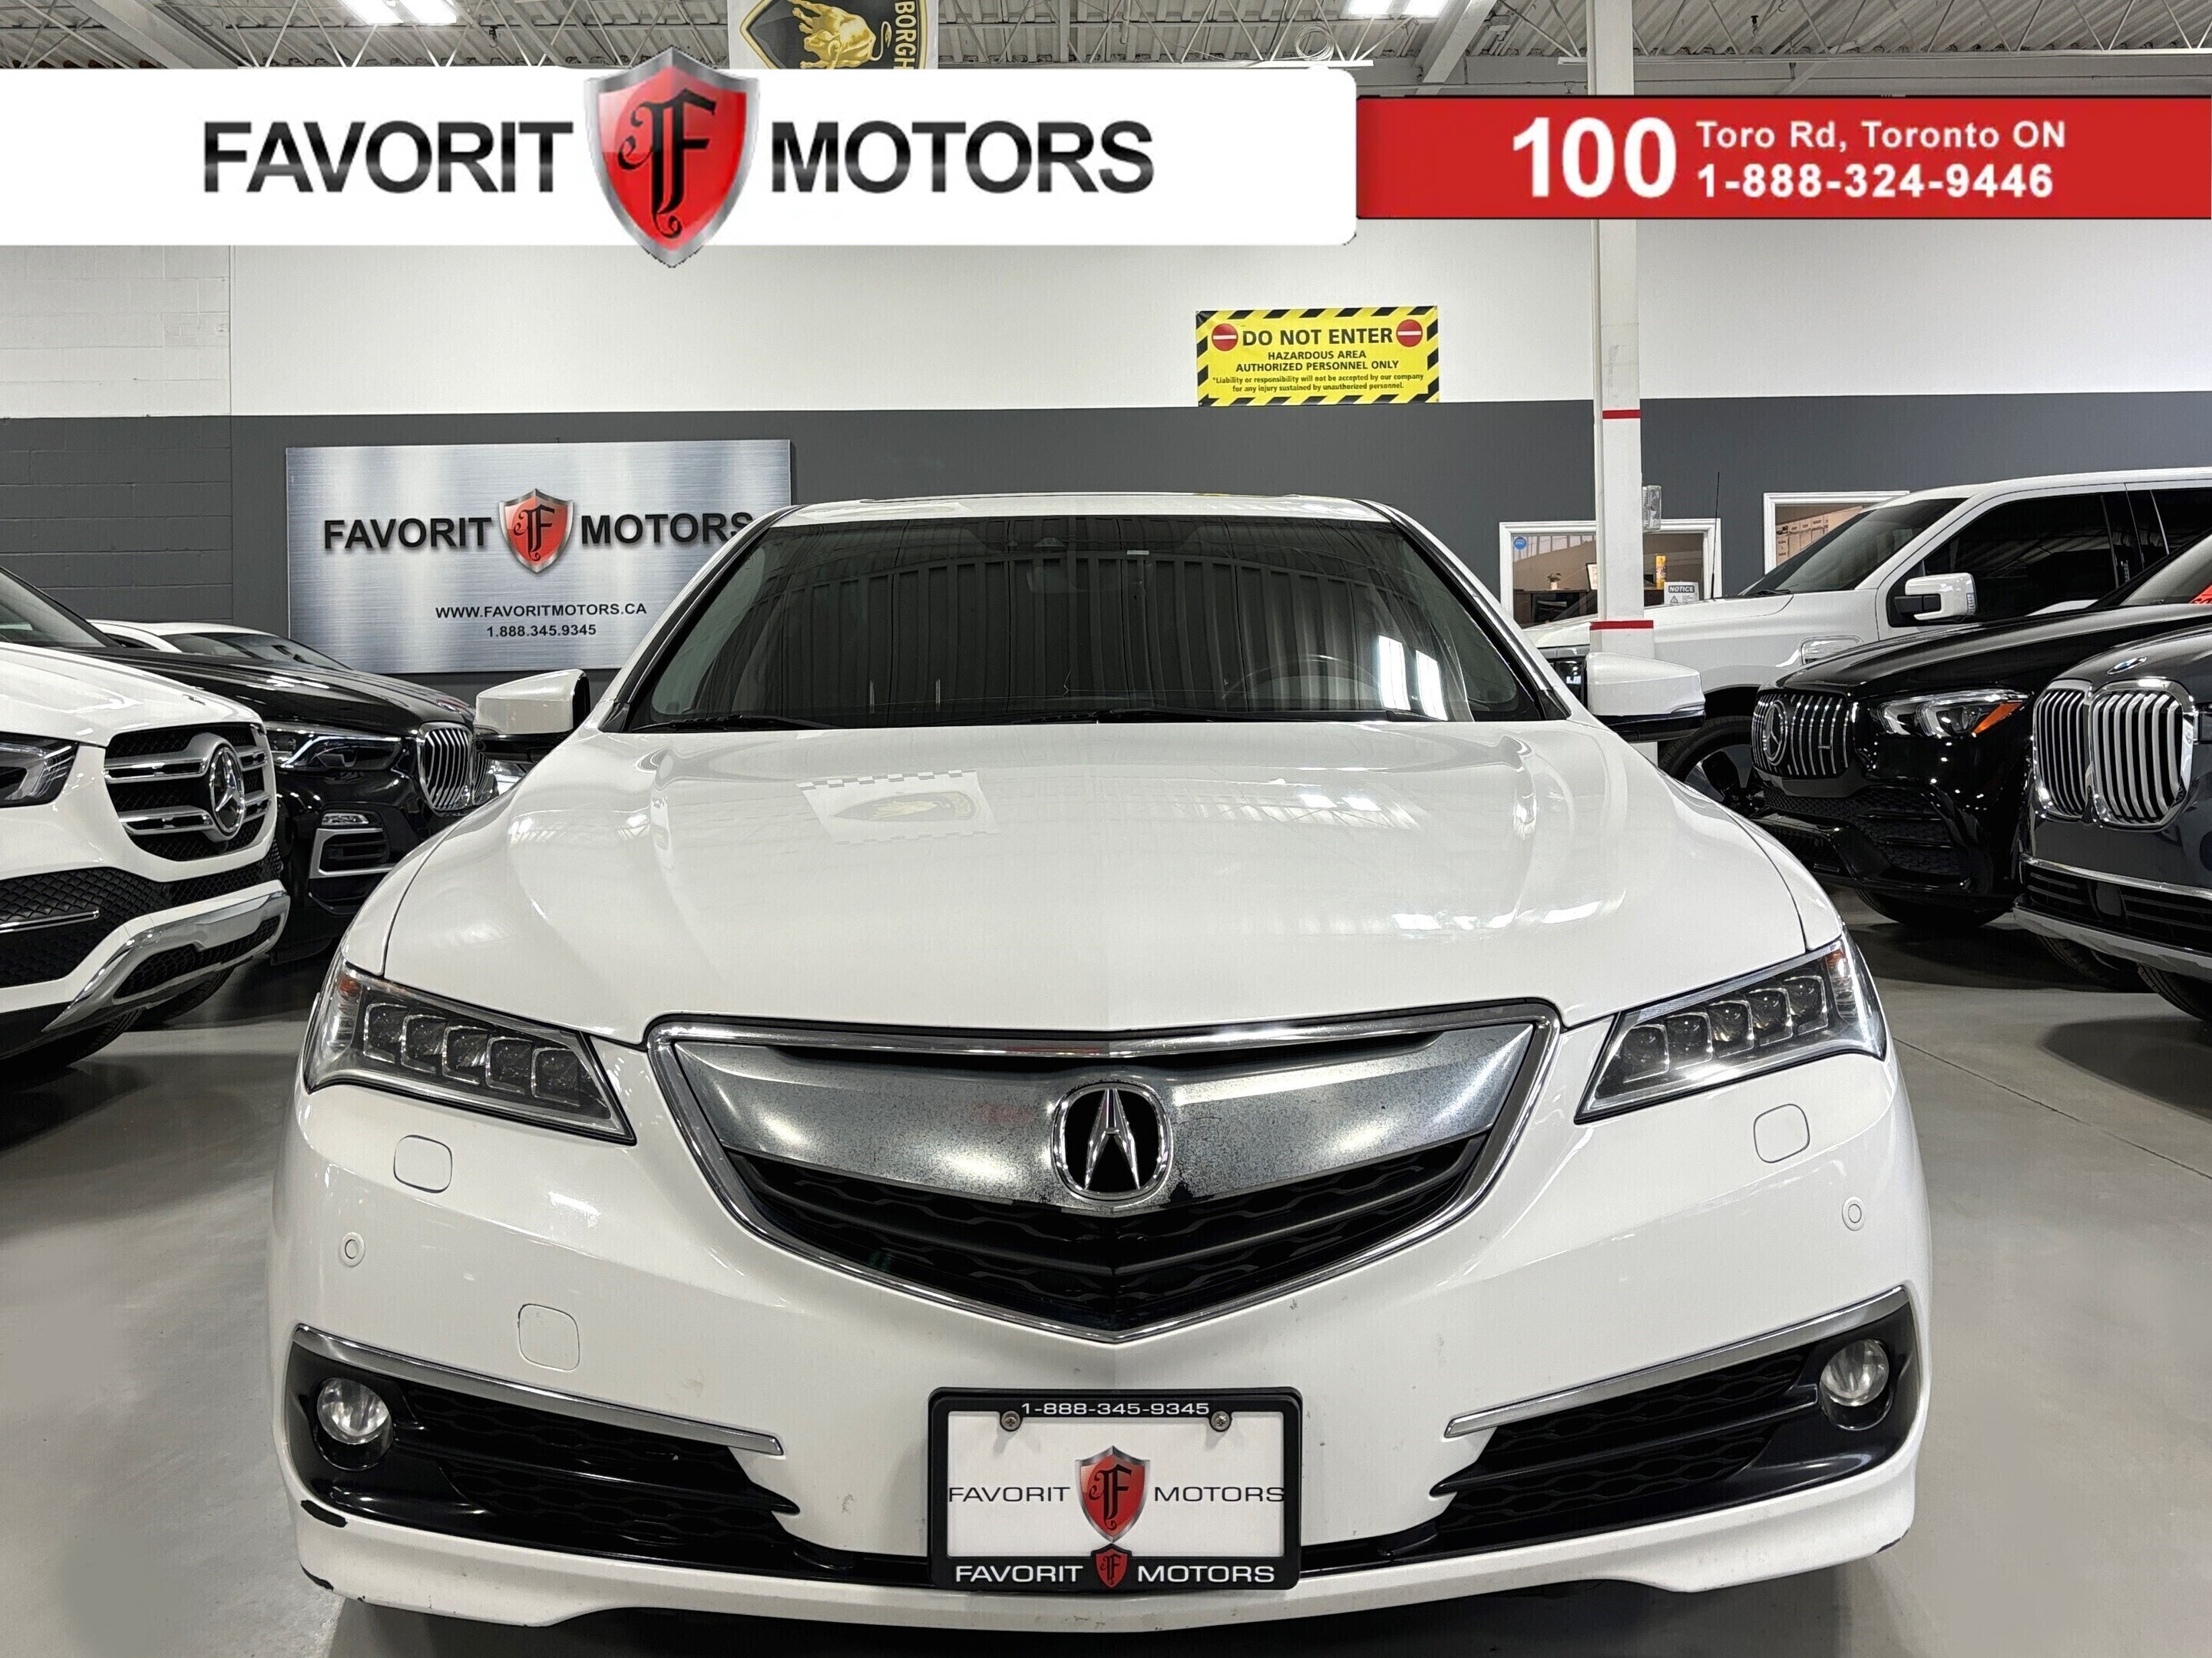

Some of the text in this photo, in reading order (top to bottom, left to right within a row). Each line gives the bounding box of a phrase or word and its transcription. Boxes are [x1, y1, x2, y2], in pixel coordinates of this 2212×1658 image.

[1242, 328, 1394, 346] DO NOT ENTER
[1268, 350, 1367, 361] HAZARDOUS AREA
[1235, 360, 1400, 372] AUTHORIZED PERSONNEL ONLY
[1254, 375, 1299, 384] responsibility
[1338, 374, 1369, 382] accepted
[1258, 385, 1278, 393] injury
[1322, 382, 1367, 391] unauthorized
[324, 517, 491, 549] FAVORIT
[580, 512, 753, 545] MOTORS
[435, 603, 647, 619] WWW.FAVORITMOTORS.CA
[486, 623, 597, 638] 1.888.345.9345
[1020, 1402, 1210, 1415] 1-888-345-9345
[949, 1487, 1071, 1502] FAVORIT
[1155, 1487, 1285, 1502] MOTORS
[955, 1564, 1083, 1583] FAVORIT
[1138, 1564, 1275, 1583] MOTORS
